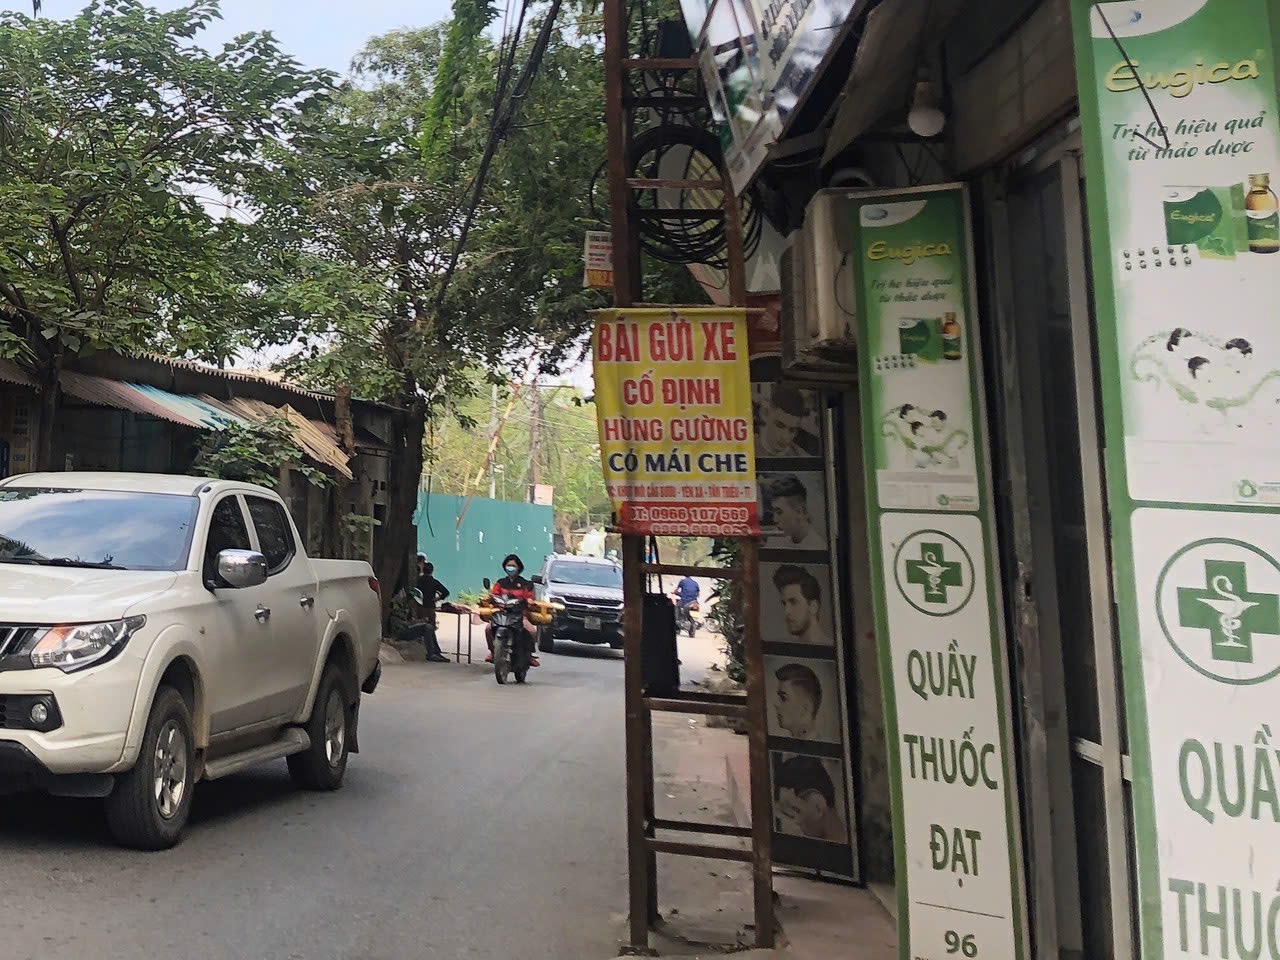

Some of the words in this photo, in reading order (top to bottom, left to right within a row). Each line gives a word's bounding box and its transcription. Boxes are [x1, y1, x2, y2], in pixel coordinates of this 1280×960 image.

[1104, 57, 1261, 99] Eugica
[1175, 115, 1218, 136] hiệu
[1224, 110, 1267, 134] quả
[867, 240, 953, 266] Eugica
[701, 321, 737, 361] XE
[623, 369, 655, 406] CỐ
[661, 378, 721, 410] ĐỊNH
[604, 415, 664, 441] HÙNG
[670, 414, 748, 442] CƯỜNG
[608, 448, 638, 473] CÓ
[645, 448, 691, 473] MÁI
[698, 453, 748, 473] CHE
[651, 508, 687, 521] 0966
[691, 509, 717, 521] 107
[721, 509, 748, 522] 569
[906, 639, 978, 701] QUẦY
[903, 726, 999, 791] THUỐC
[1178, 723, 1280, 825] QUẦ
[929, 823, 983, 888] ĐẠT
[944, 929, 979, 958] 96
